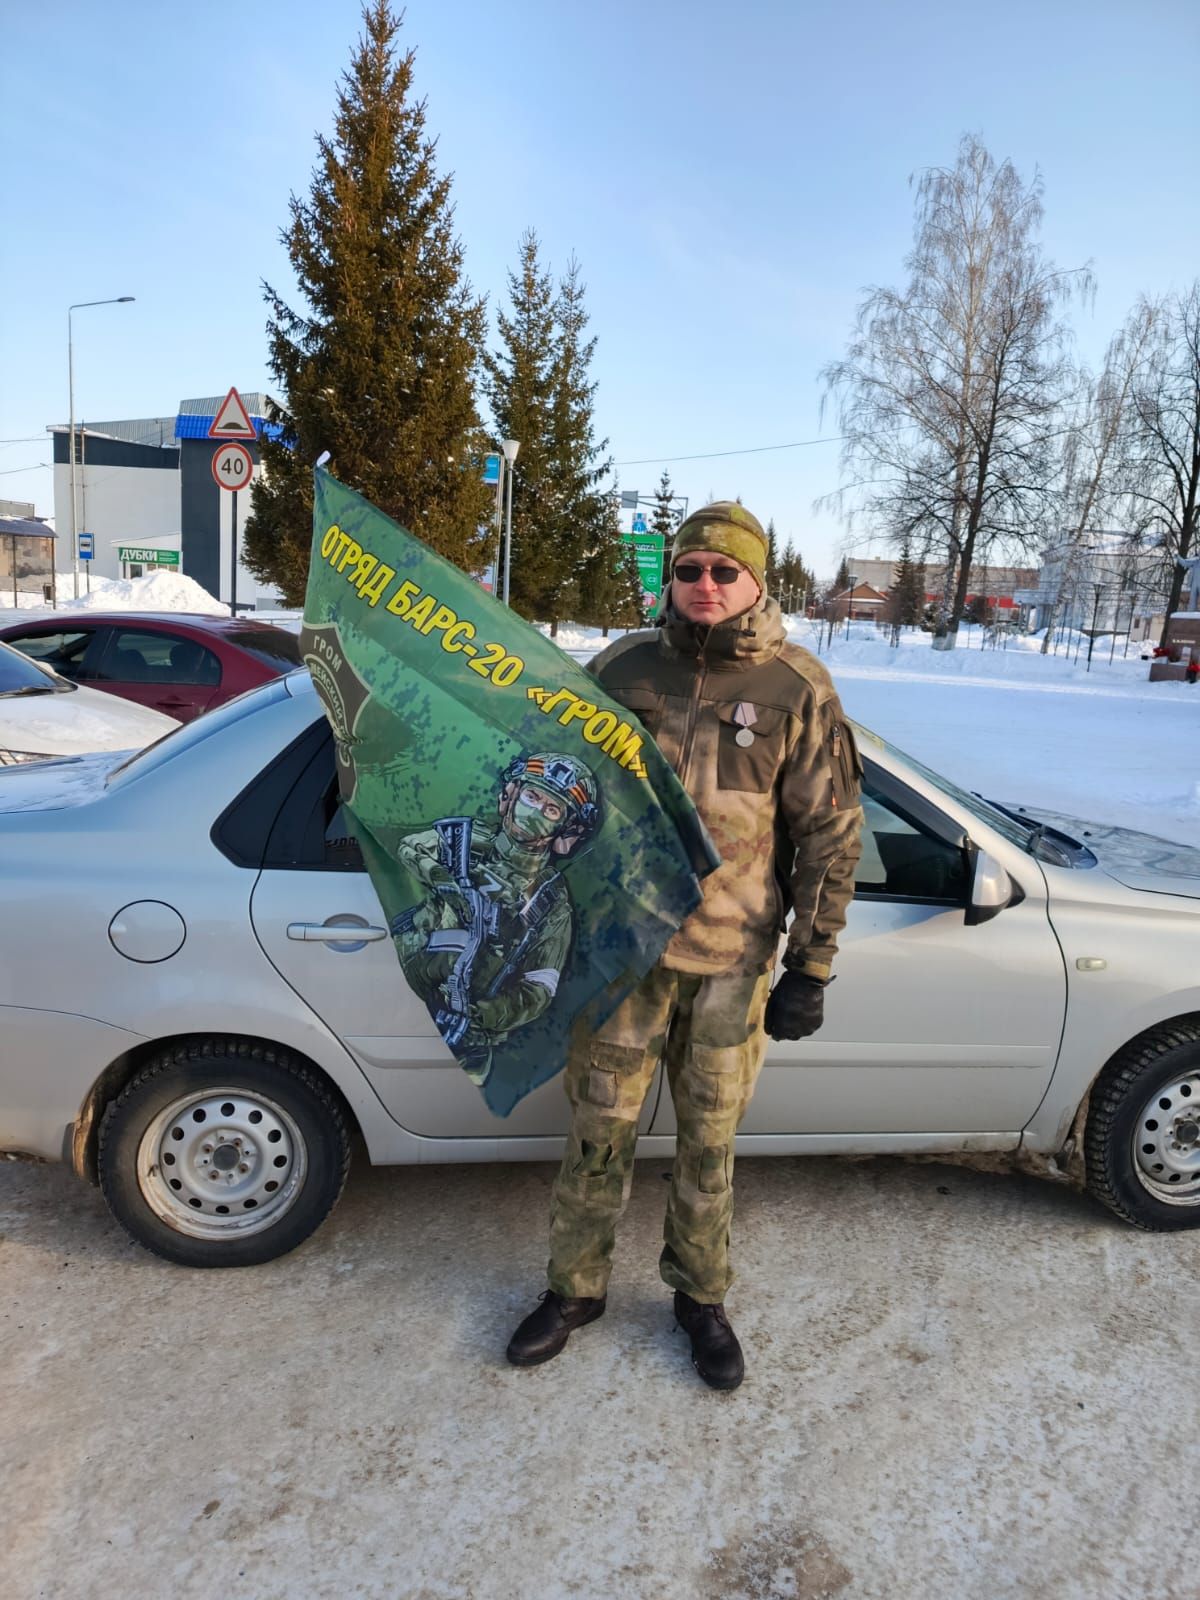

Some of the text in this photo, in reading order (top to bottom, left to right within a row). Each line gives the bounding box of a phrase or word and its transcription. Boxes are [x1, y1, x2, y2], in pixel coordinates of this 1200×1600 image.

[221, 458, 244, 475] 40
[120, 549, 157, 561] ДУБКИ
[313, 634, 342, 673] ГРОМ
[321, 525, 648, 778] ОТРЯД БАРС-20 «ГРОМ»
